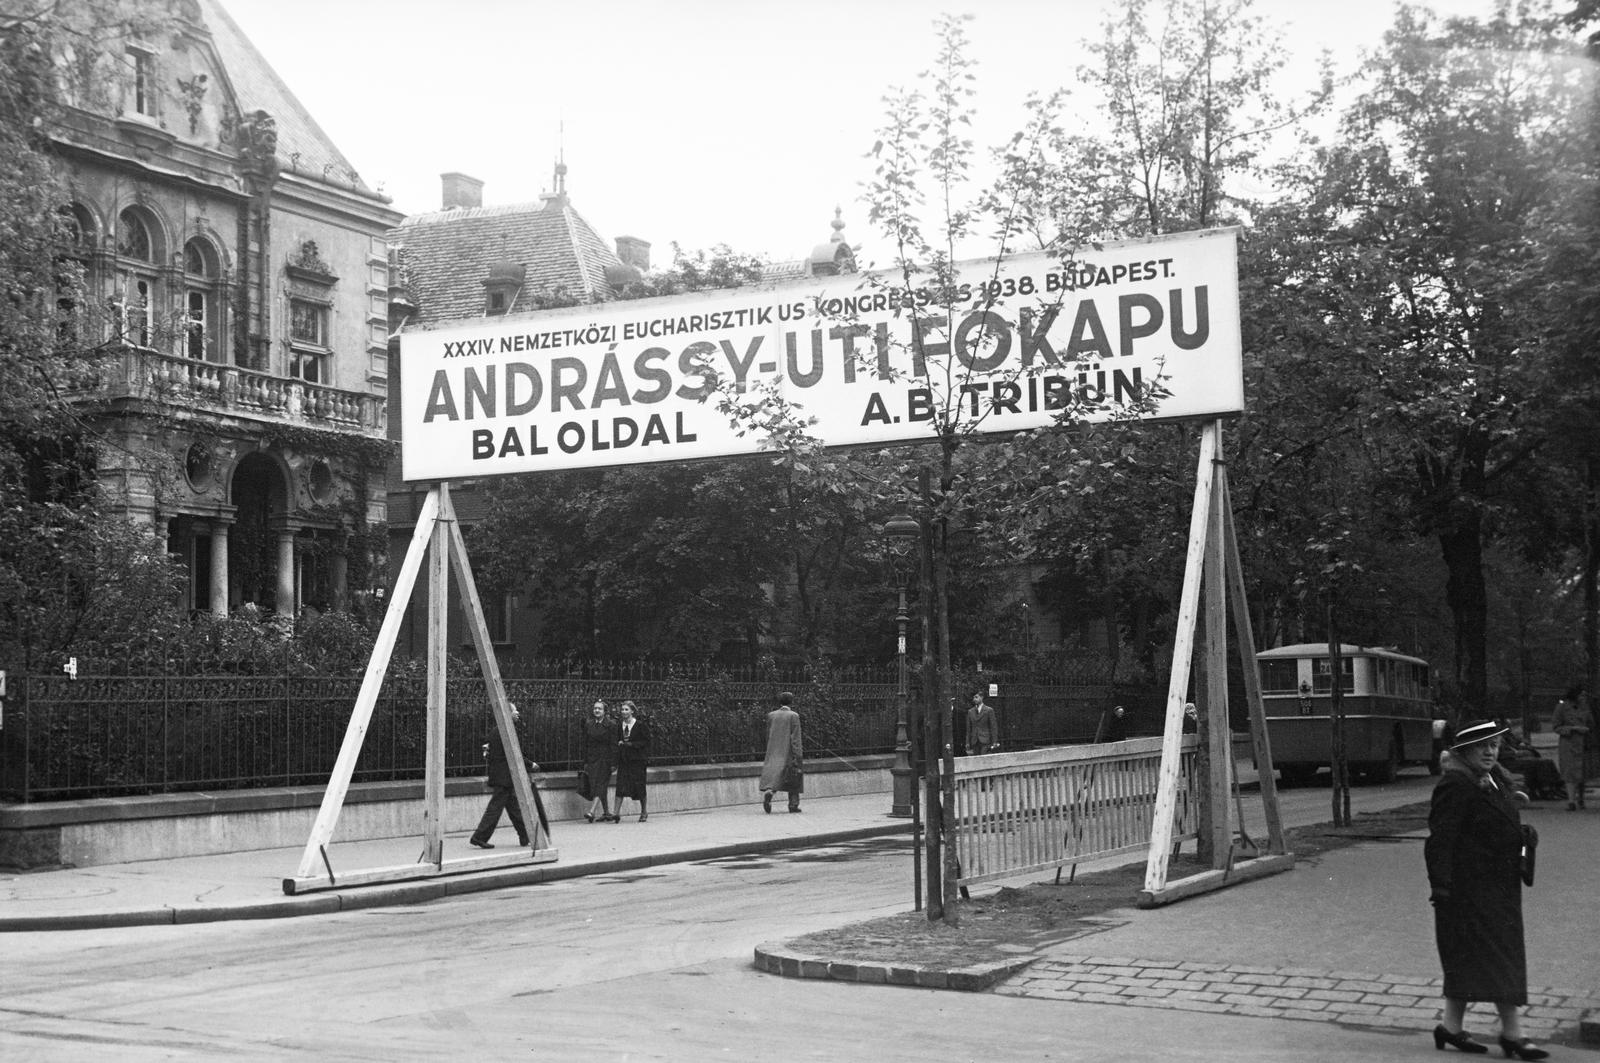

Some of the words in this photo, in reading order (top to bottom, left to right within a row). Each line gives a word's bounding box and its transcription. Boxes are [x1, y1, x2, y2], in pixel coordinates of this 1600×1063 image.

[443, 338, 495, 359] XXXIV.
[500, 323, 616, 352] NEMZETKÖZI
[1046, 258, 1175, 293] BUDAPEST.
[960, 363, 1143, 417] TRIBÜN
